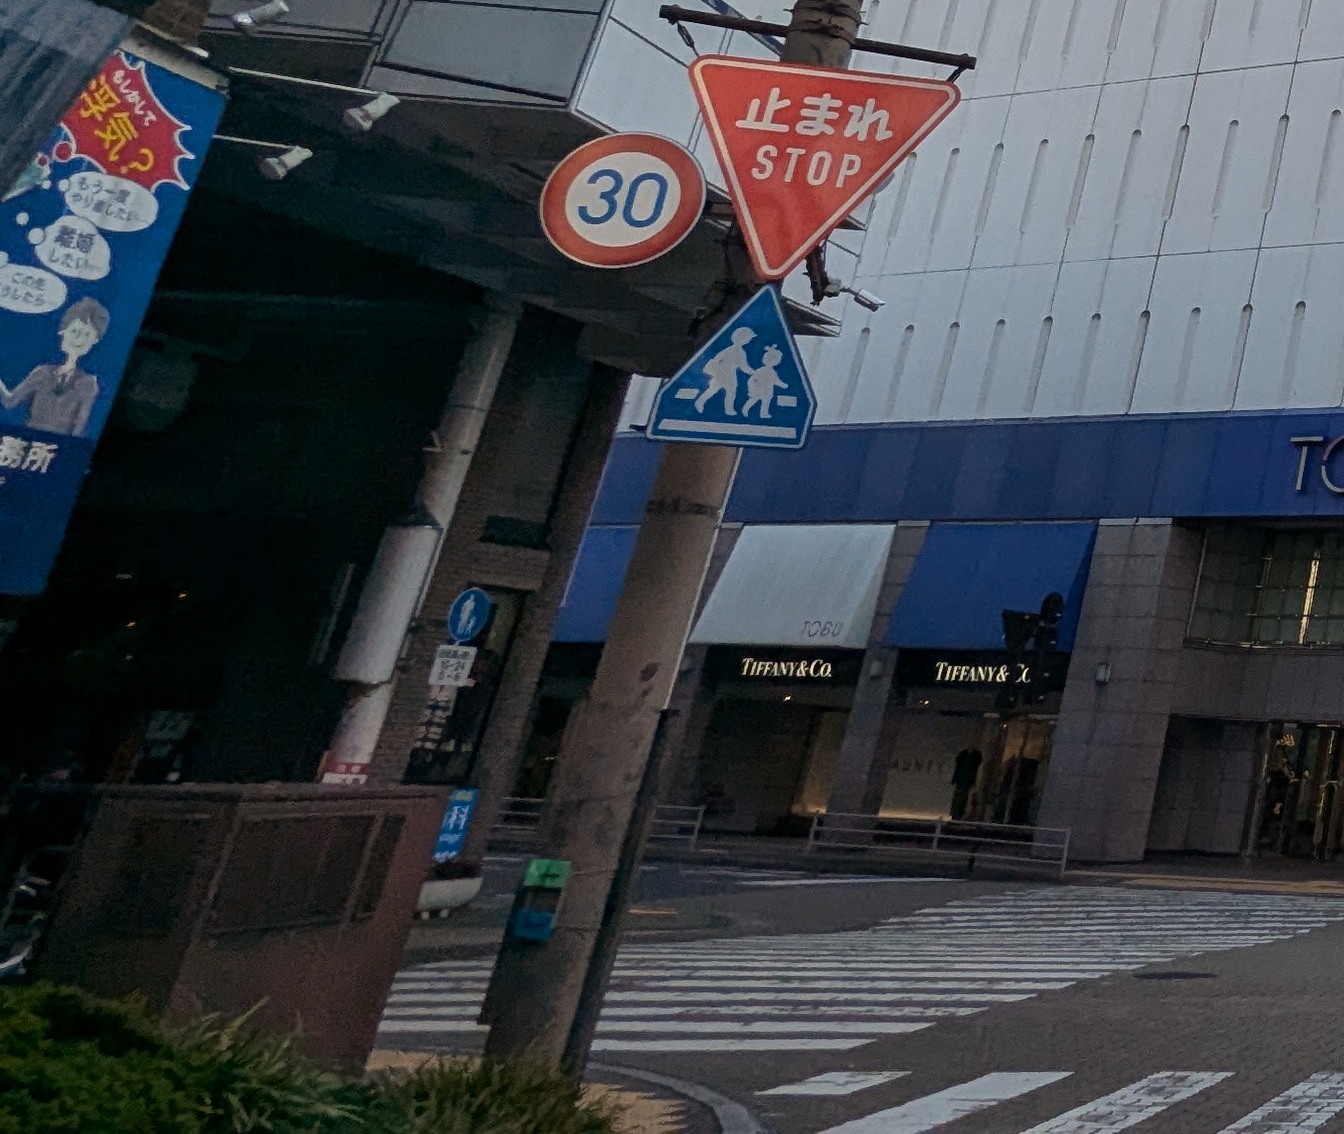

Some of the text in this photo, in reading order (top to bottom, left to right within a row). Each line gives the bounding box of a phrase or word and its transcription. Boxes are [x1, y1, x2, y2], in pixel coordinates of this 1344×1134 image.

[735, 87, 893, 141] 止まれ
[751, 145, 862, 188] STOP
[577, 168, 669, 228] 30
[802, 620, 844, 636] TOBU
